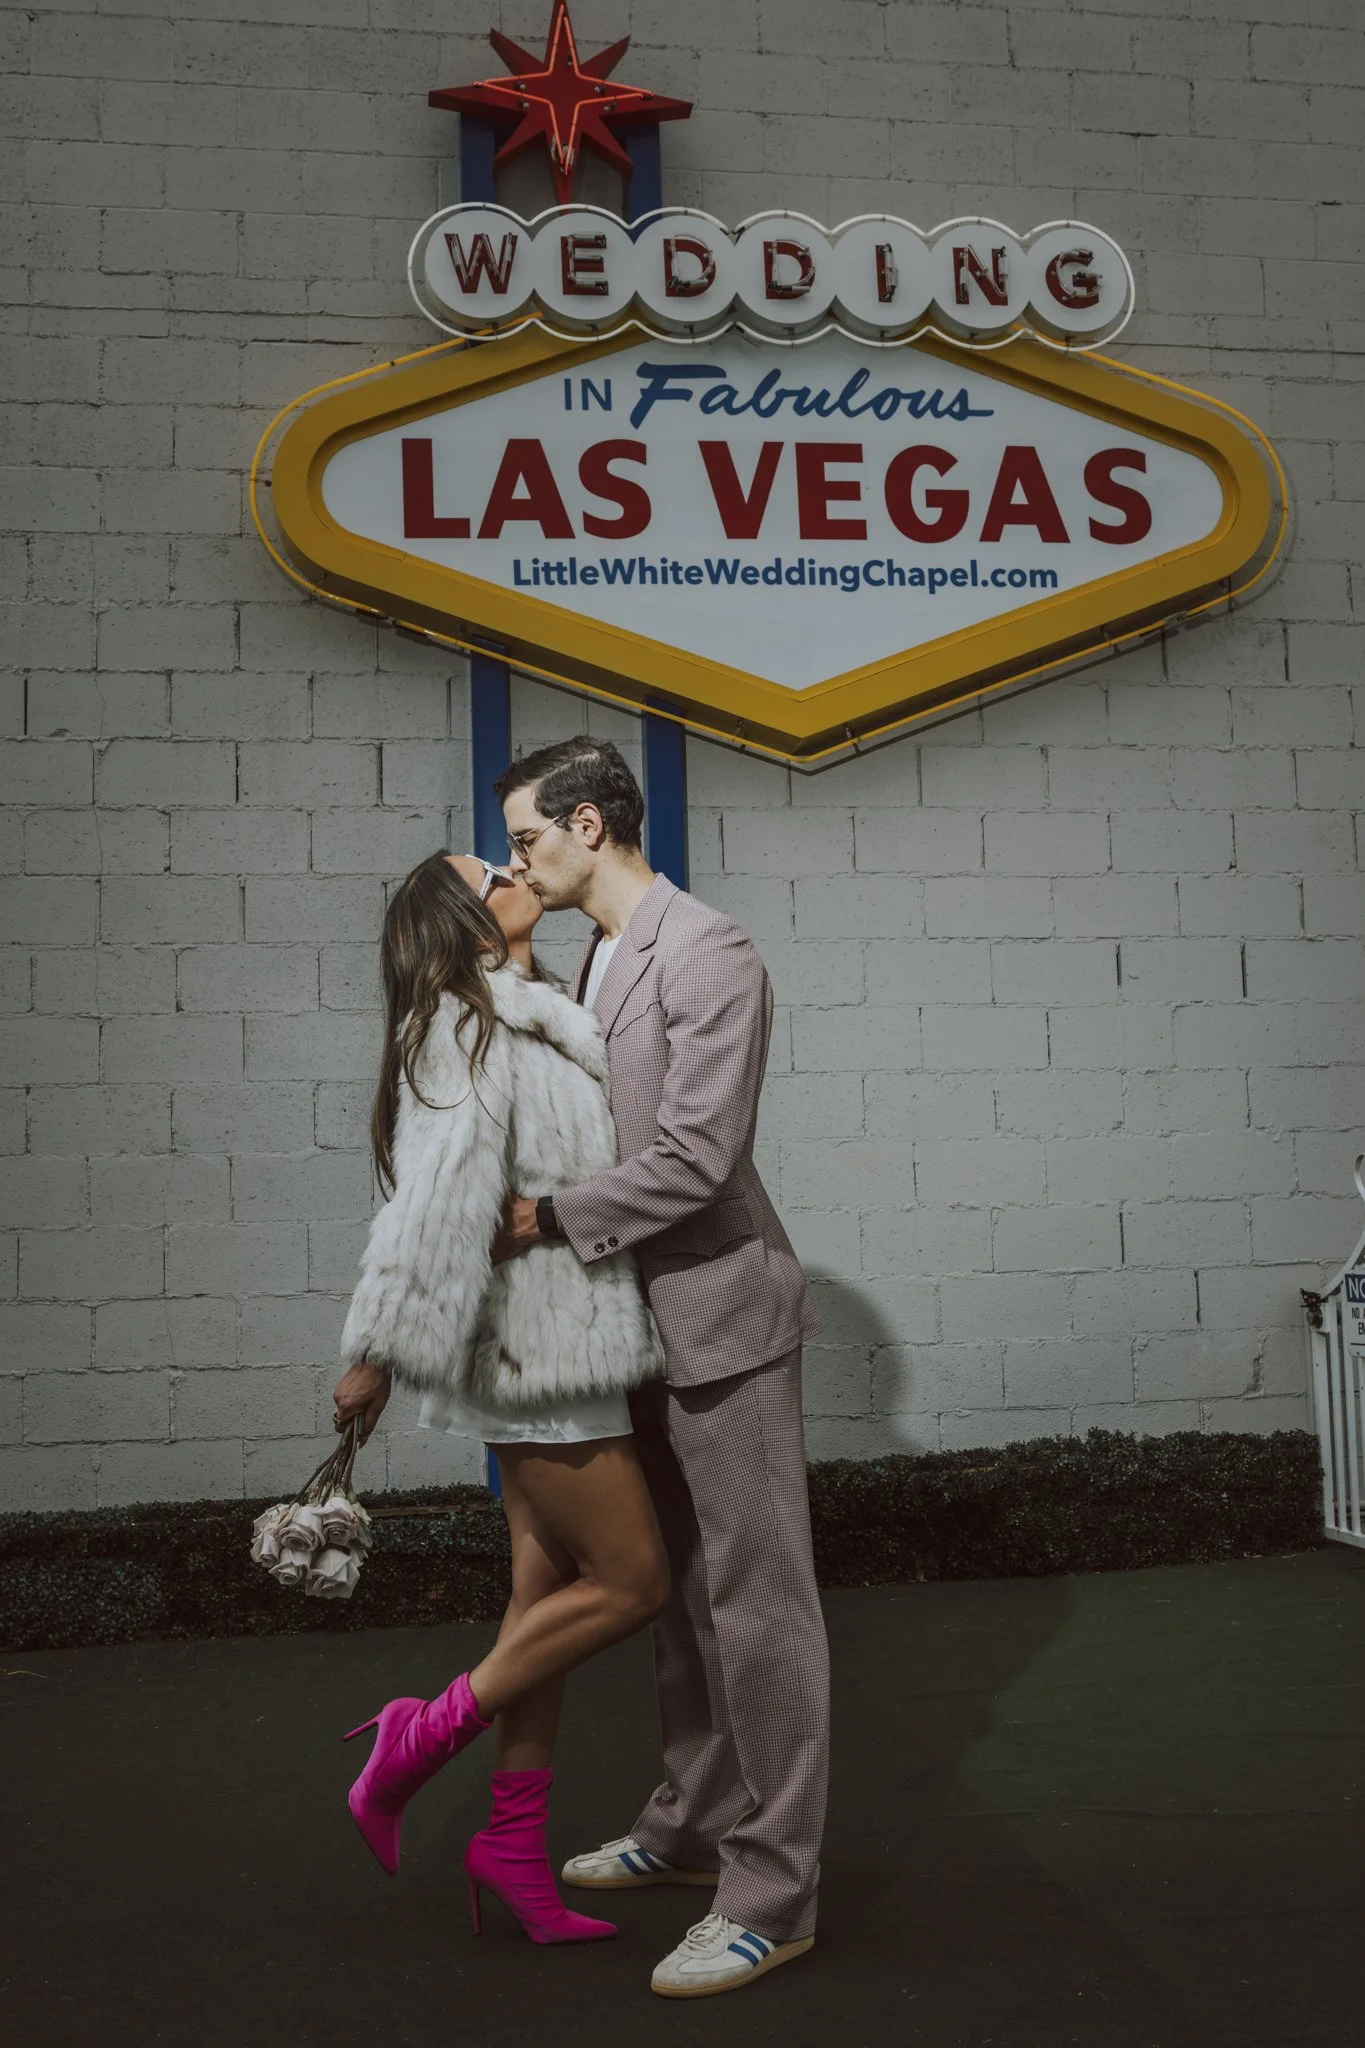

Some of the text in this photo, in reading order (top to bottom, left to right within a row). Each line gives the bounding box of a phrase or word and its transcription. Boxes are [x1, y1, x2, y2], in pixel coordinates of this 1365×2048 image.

[444, 231, 1103, 309] WEDDING
[564, 360, 994, 429] IN Fabulous
[401, 437, 1153, 545] LAS VEGAS
[512, 557, 1059, 595] LittleWhiteWeddingChapel.com
